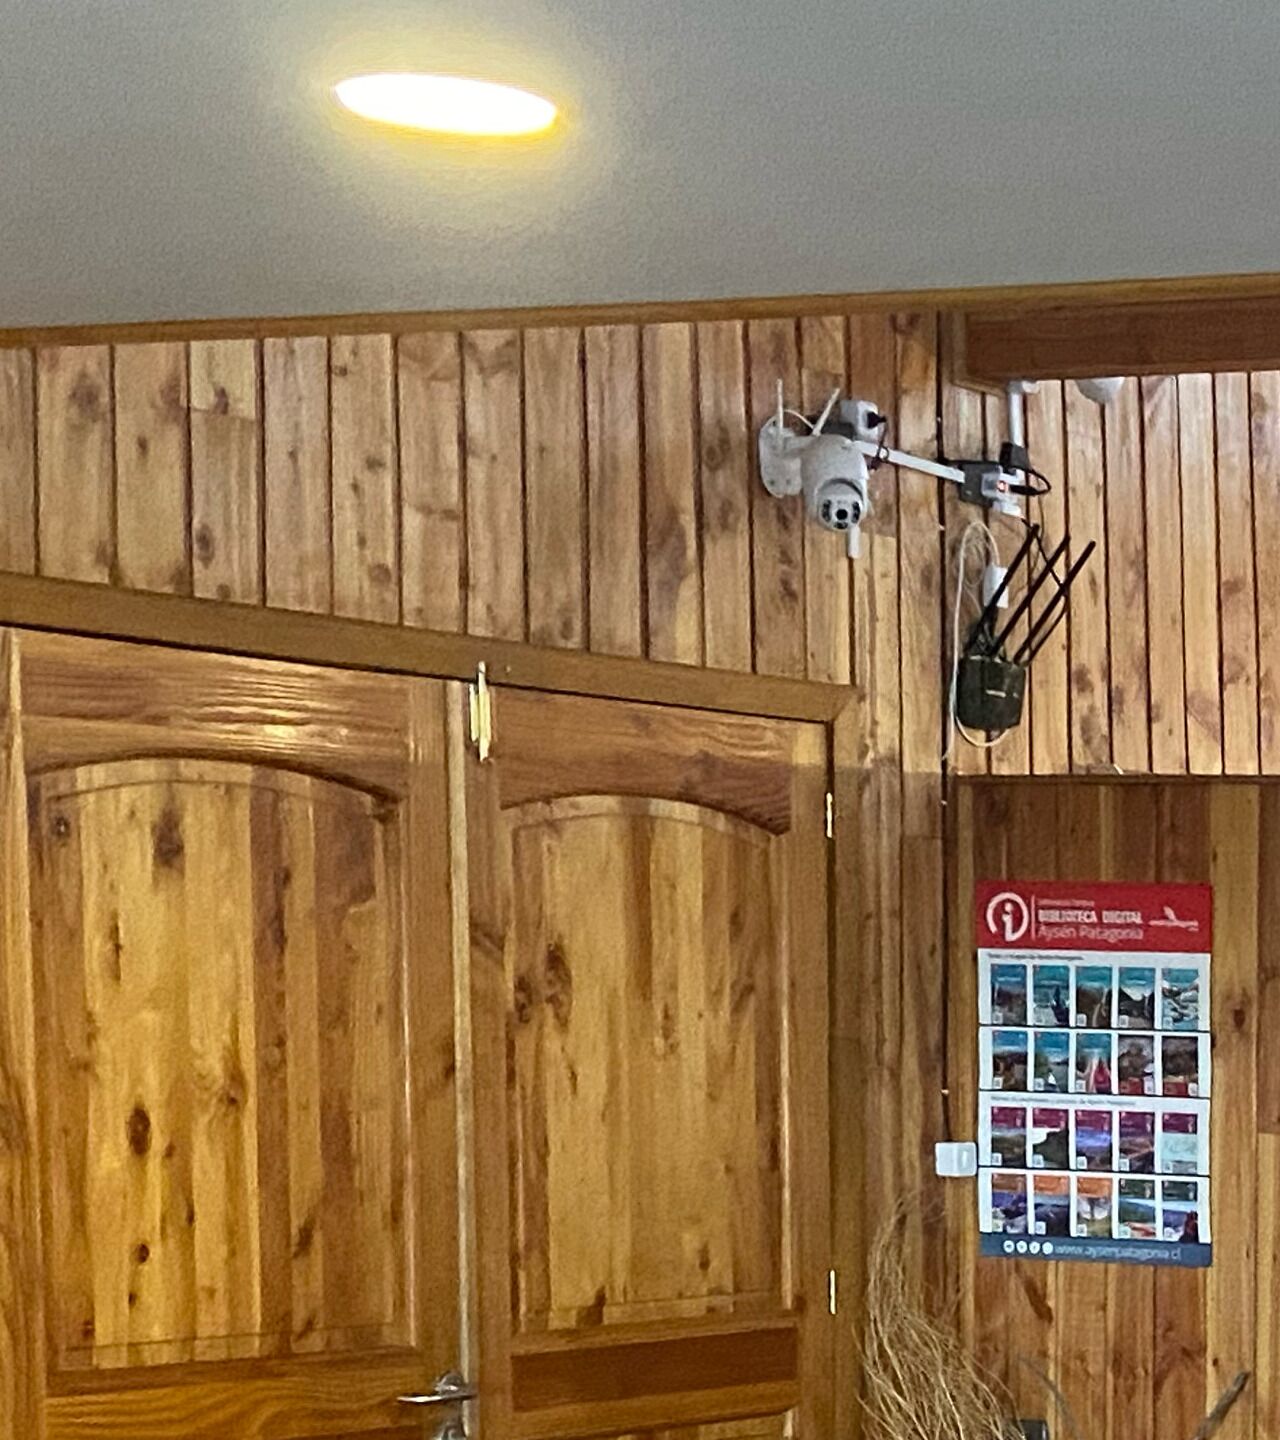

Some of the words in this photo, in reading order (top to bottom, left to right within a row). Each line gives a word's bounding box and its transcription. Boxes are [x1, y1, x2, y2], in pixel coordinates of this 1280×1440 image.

[1038, 909, 1097, 923] BIBLIOTECA
[1102, 910, 1143, 924] DIGITAL
[1038, 924, 1077, 941] Aysén
[1079, 925, 1144, 944] Patagonia
